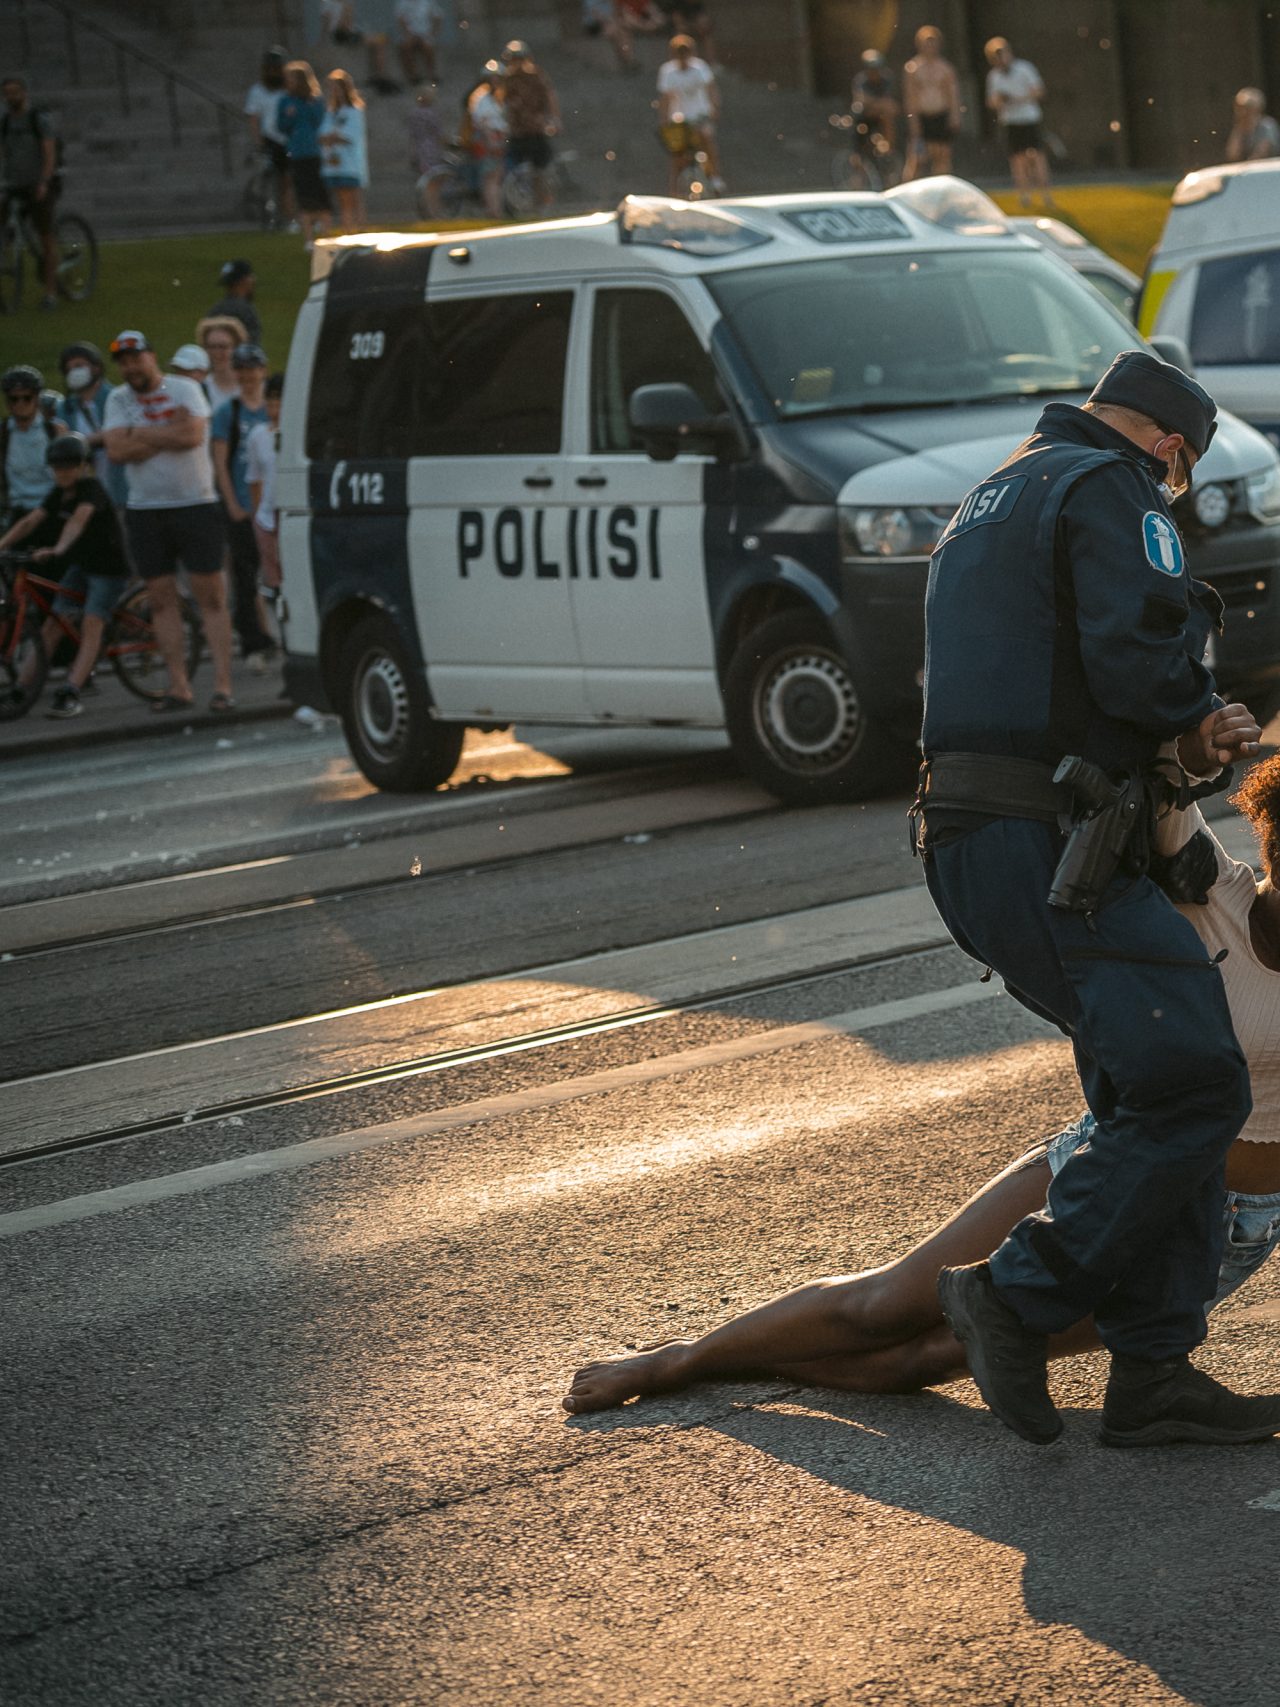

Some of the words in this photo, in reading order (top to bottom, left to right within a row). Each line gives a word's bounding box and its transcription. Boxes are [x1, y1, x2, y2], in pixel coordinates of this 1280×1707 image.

[797, 207, 911, 238] POLIISI
[349, 473, 385, 504] 112
[457, 506, 661, 579] POLIISI
